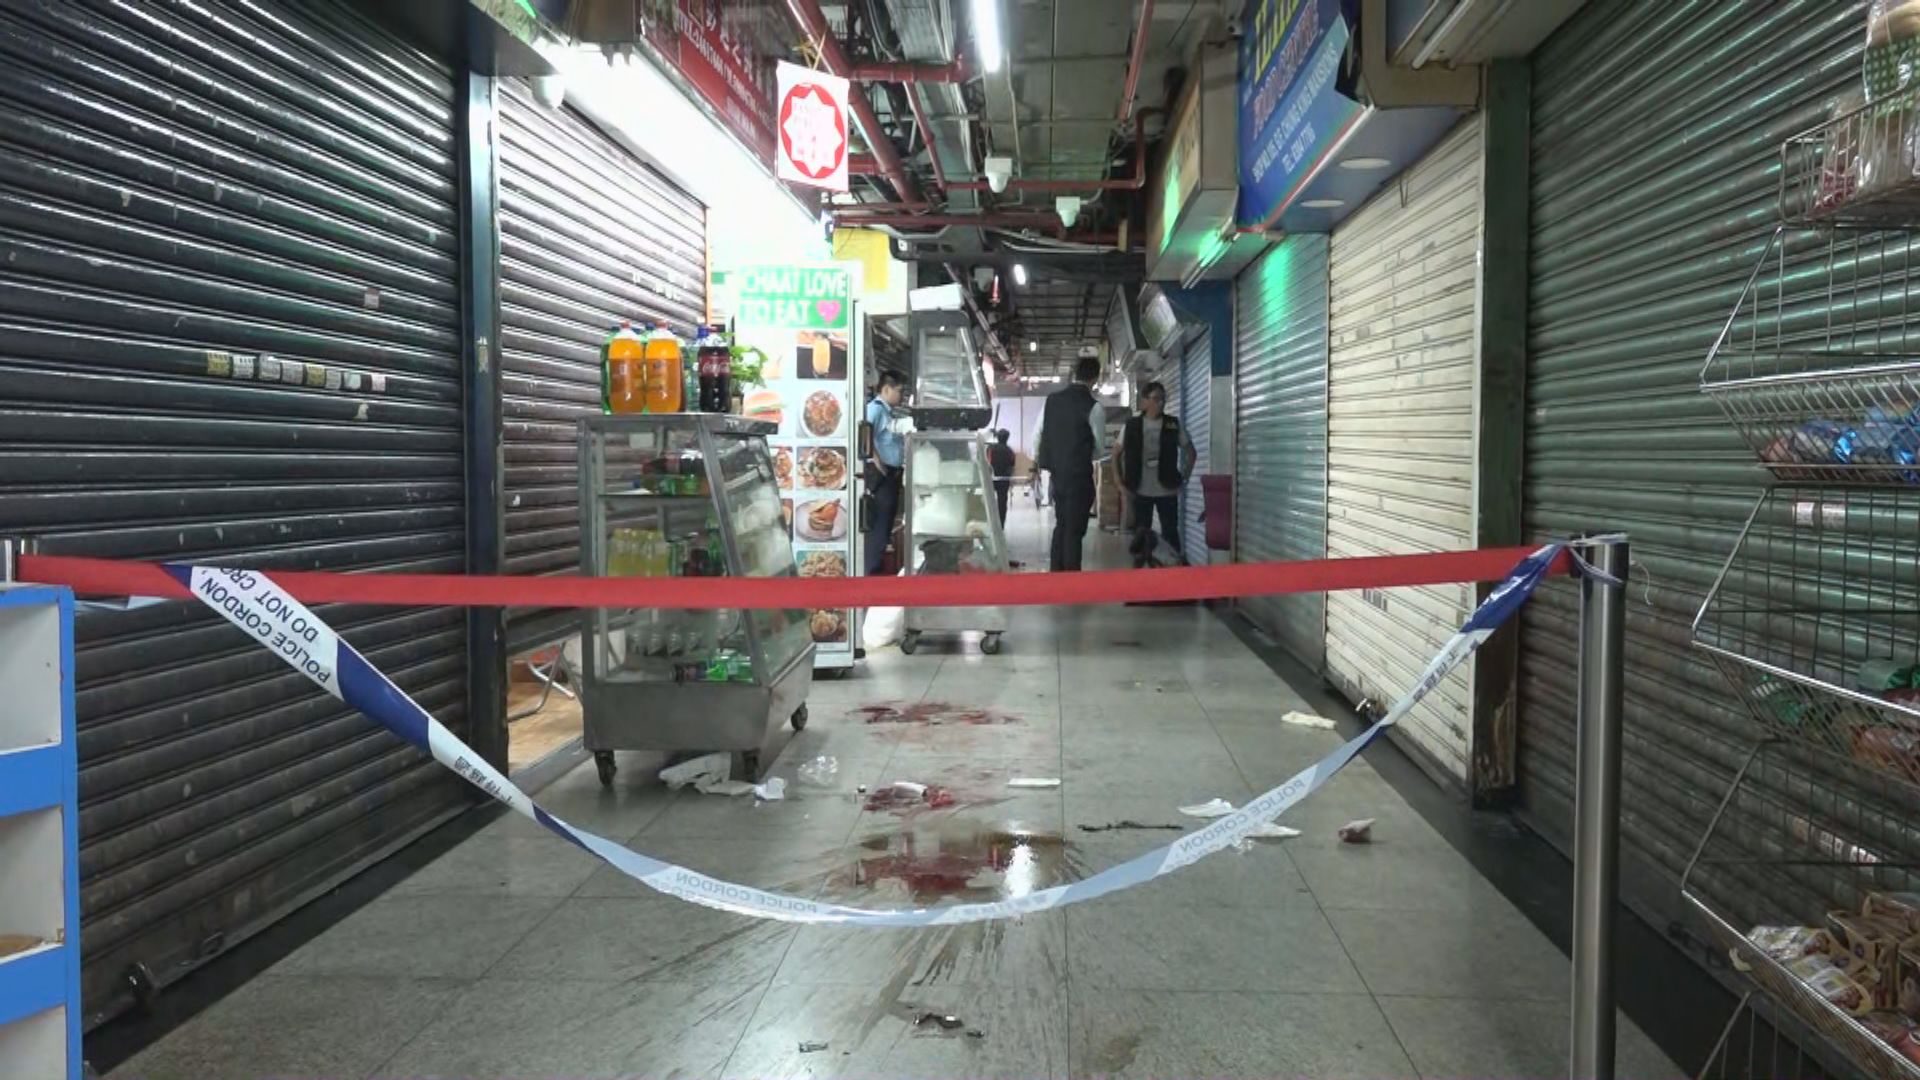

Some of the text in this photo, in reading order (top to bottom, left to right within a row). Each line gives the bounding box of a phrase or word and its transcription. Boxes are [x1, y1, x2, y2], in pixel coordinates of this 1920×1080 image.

[805, 270, 847, 297] LOVE
[740, 300, 811, 325] TO EAT
[254, 590, 295, 623] NOT
[291, 618, 320, 643] DO
[272, 633, 331, 684] POLICE
